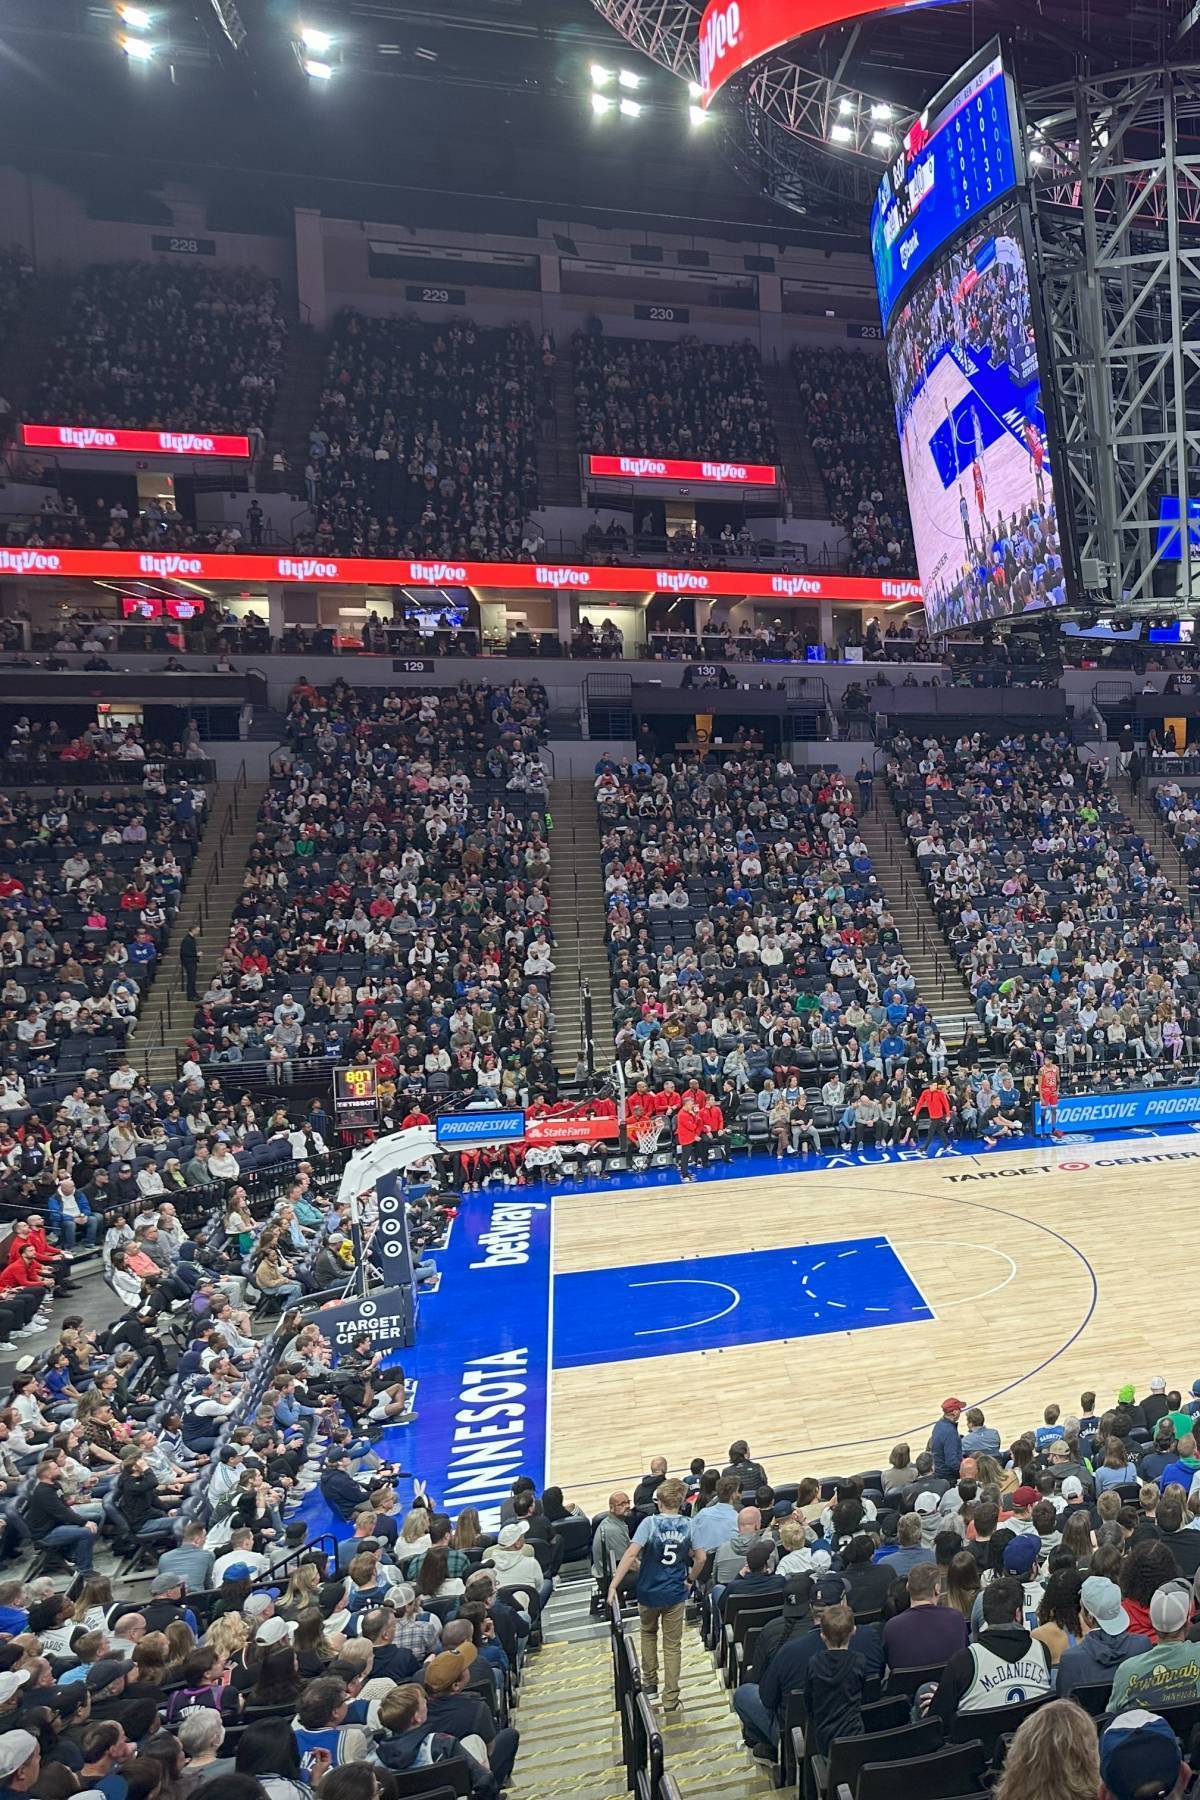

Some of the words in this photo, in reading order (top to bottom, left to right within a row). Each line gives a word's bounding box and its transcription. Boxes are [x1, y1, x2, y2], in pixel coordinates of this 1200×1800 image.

[170, 239, 198, 252] 228
[423, 289, 448, 302] 229
[649, 308, 673, 320] 230
[60, 427, 116, 448] HyVee
[159, 432, 214, 453] HyVee
[620, 457, 667, 476] HyVee
[702, 462, 747, 480] HyVee
[140, 554, 203, 579] HyVee
[278, 559, 338, 583] HyVee
[410, 563, 466, 585] HyVee
[536, 567, 590, 587] HyVee
[656, 570, 709, 591] HyVee
[772, 576, 820, 596] HyVee
[403, 661, 424, 671] 129
[697, 665, 715, 676] 130
[1176, 675, 1192, 684] 132
[355, 1083, 366, 1096] 8
[441, 1119, 518, 1134] PROGRESSIVE
[943, 1165, 1053, 1183] TARGET
[1094, 1151, 1200, 1167] CENTER
[469, 1202, 547, 1269] betway
[336, 1315, 400, 1333] TARGET
[661, 1544, 677, 1565] 5
[980, 1661, 1044, 1692] McDANIELS
